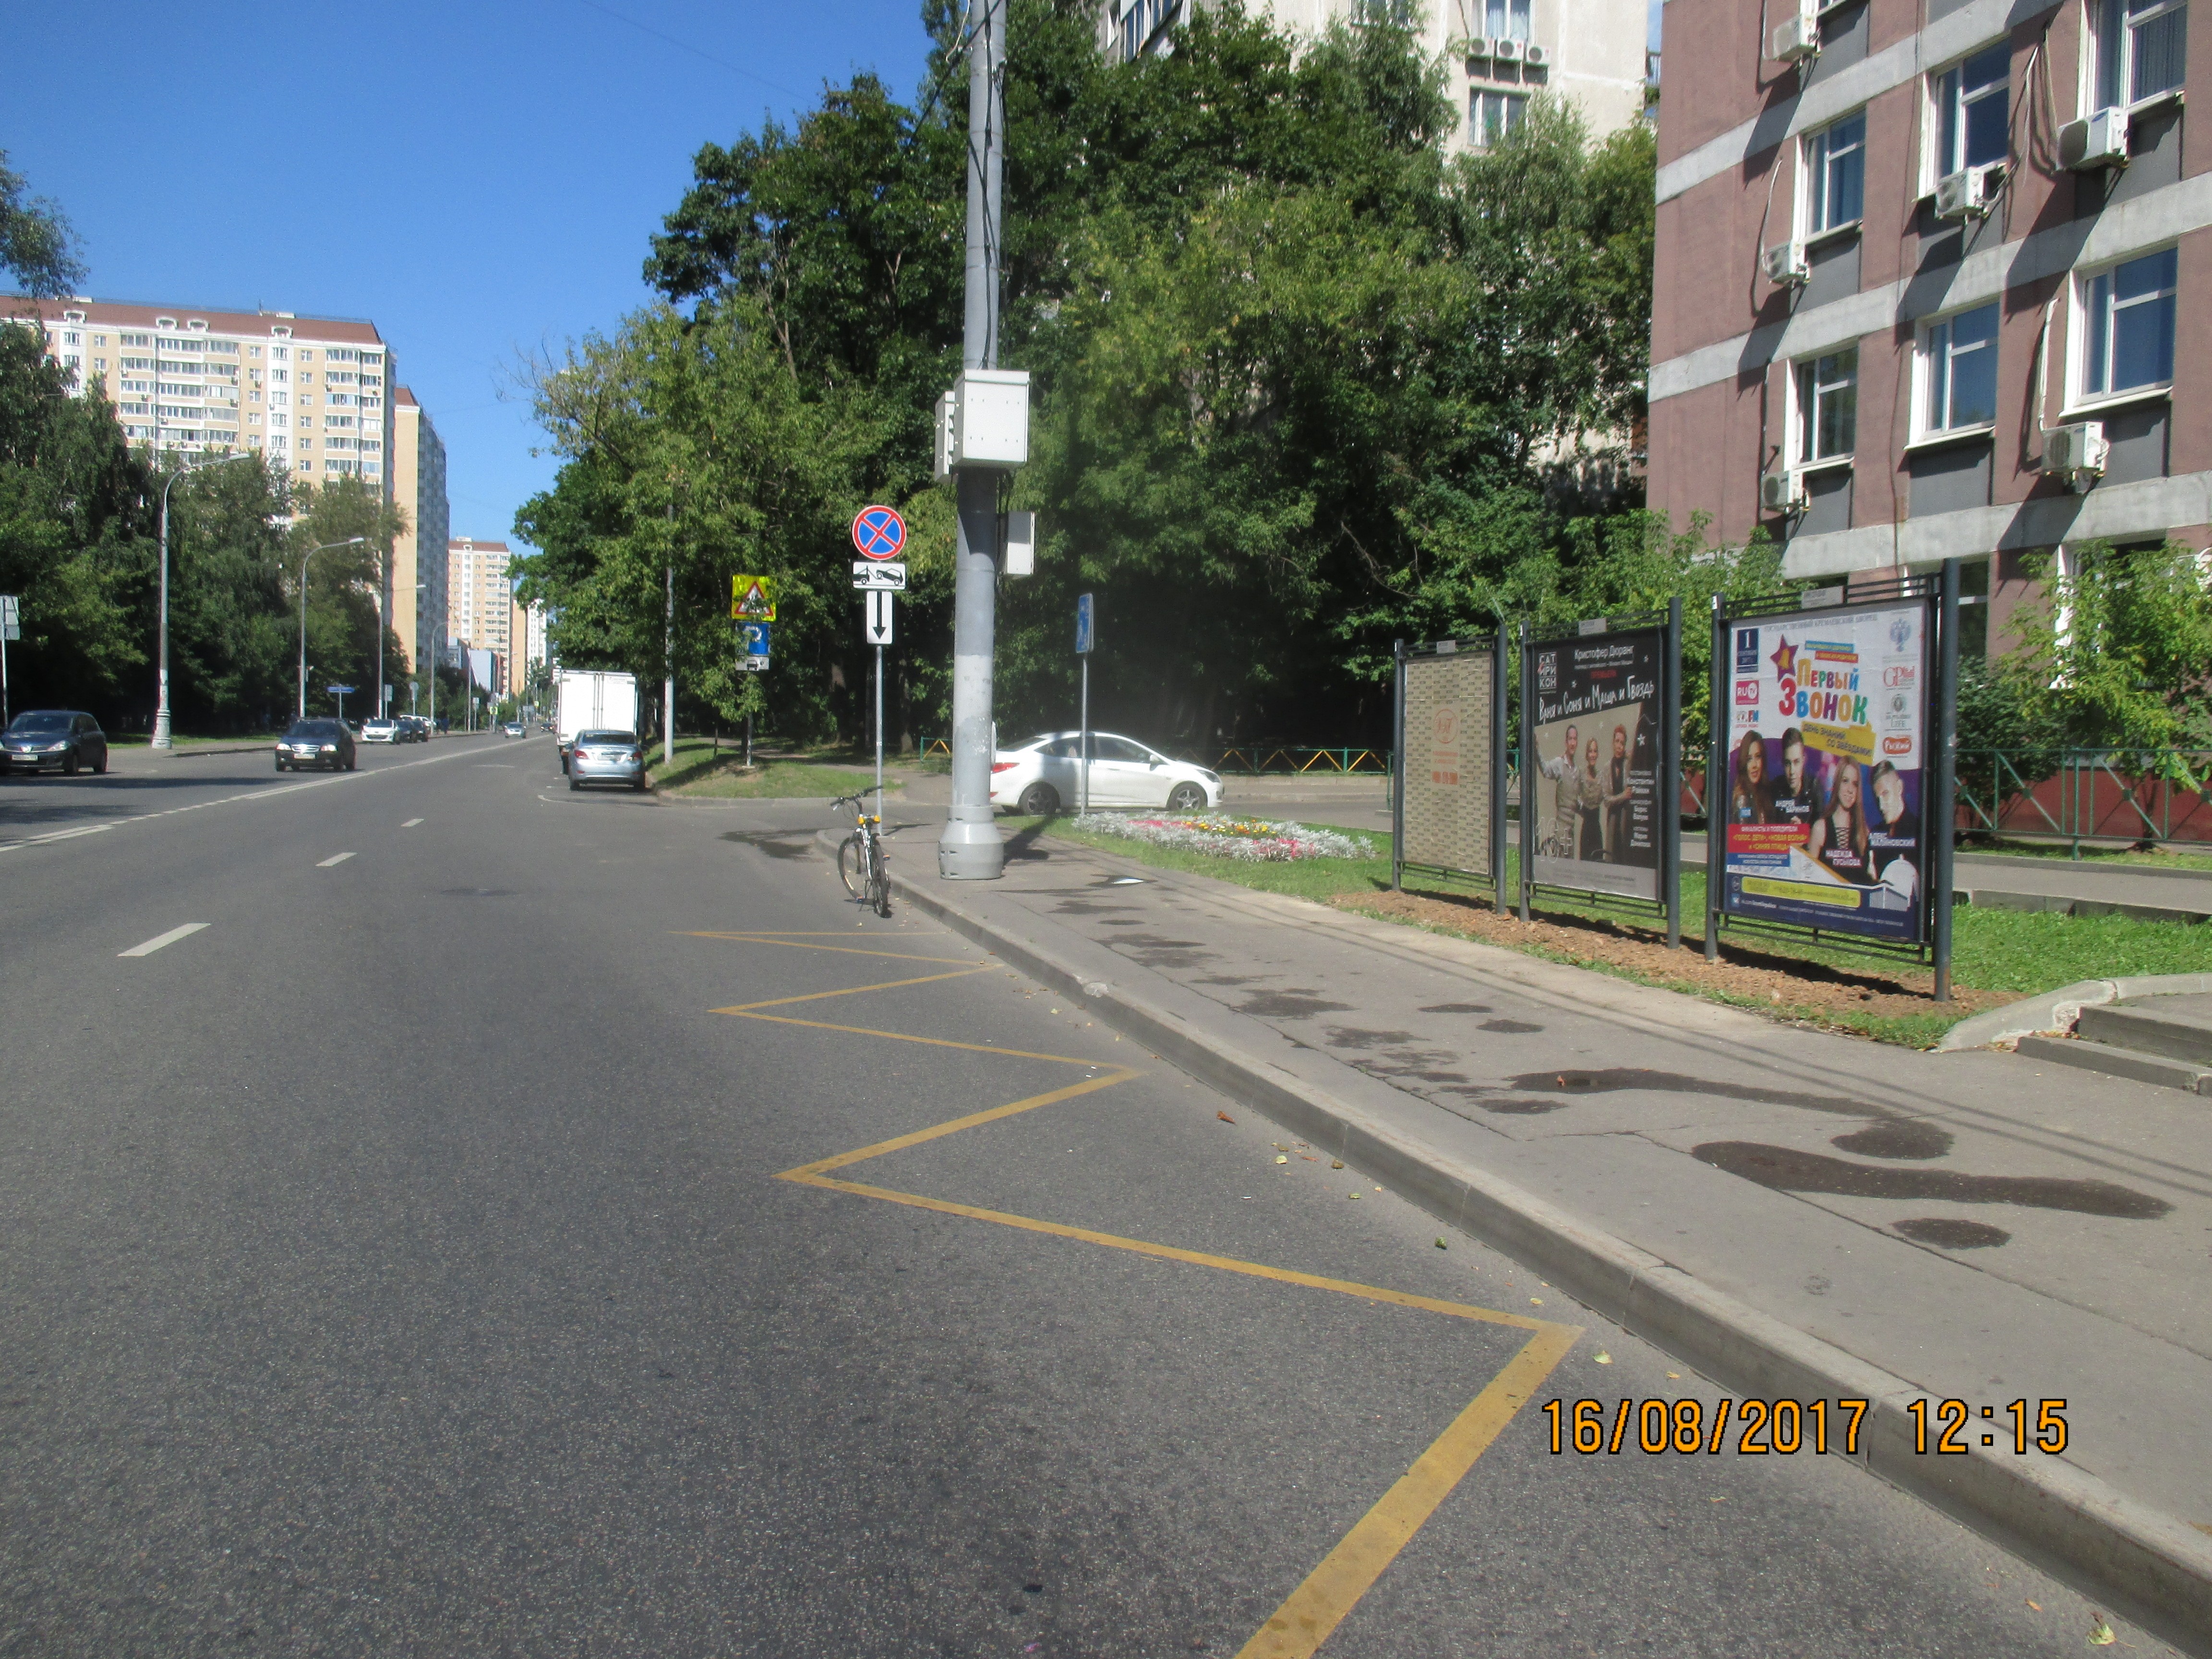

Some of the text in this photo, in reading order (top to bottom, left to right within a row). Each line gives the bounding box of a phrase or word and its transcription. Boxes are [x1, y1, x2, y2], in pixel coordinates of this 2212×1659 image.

[1744, 631, 1751, 649] 1
[1539, 654, 1556, 663] САТ
[1539, 677, 1556, 688] КОН
[1779, 677, 1868, 724] ЗВОНОК
